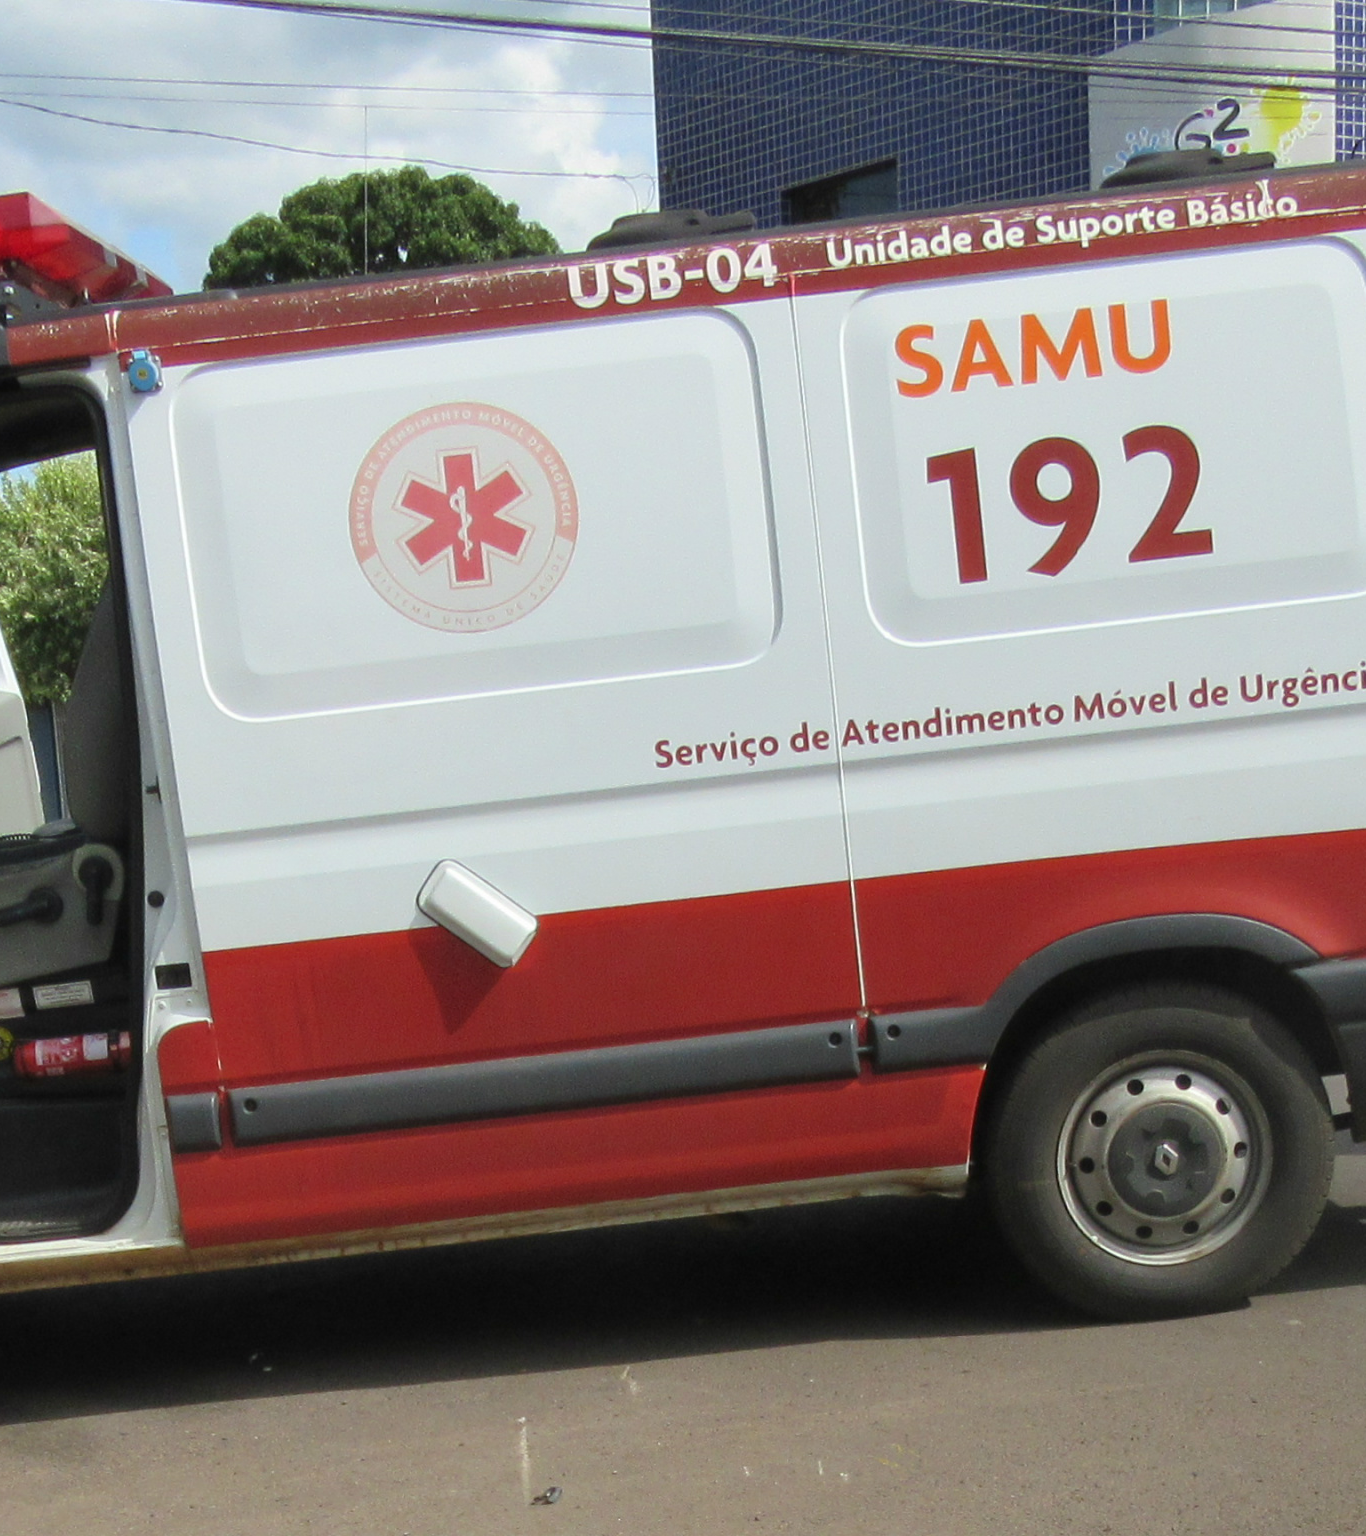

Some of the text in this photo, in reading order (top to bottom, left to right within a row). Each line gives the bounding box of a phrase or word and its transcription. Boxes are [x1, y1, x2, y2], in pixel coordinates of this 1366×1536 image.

[826, 193, 1298, 267] Unidade de Suporte Básico
[566, 243, 778, 309] USB-04
[895, 299, 1171, 398] SAMU
[926, 425, 1214, 584] 192
[654, 731, 779, 768] Serviço
[790, 722, 829, 752] de
[841, 702, 1065, 747] Atendimento
[1073, 680, 1178, 722] Móvel
[1189, 677, 1229, 709] de
